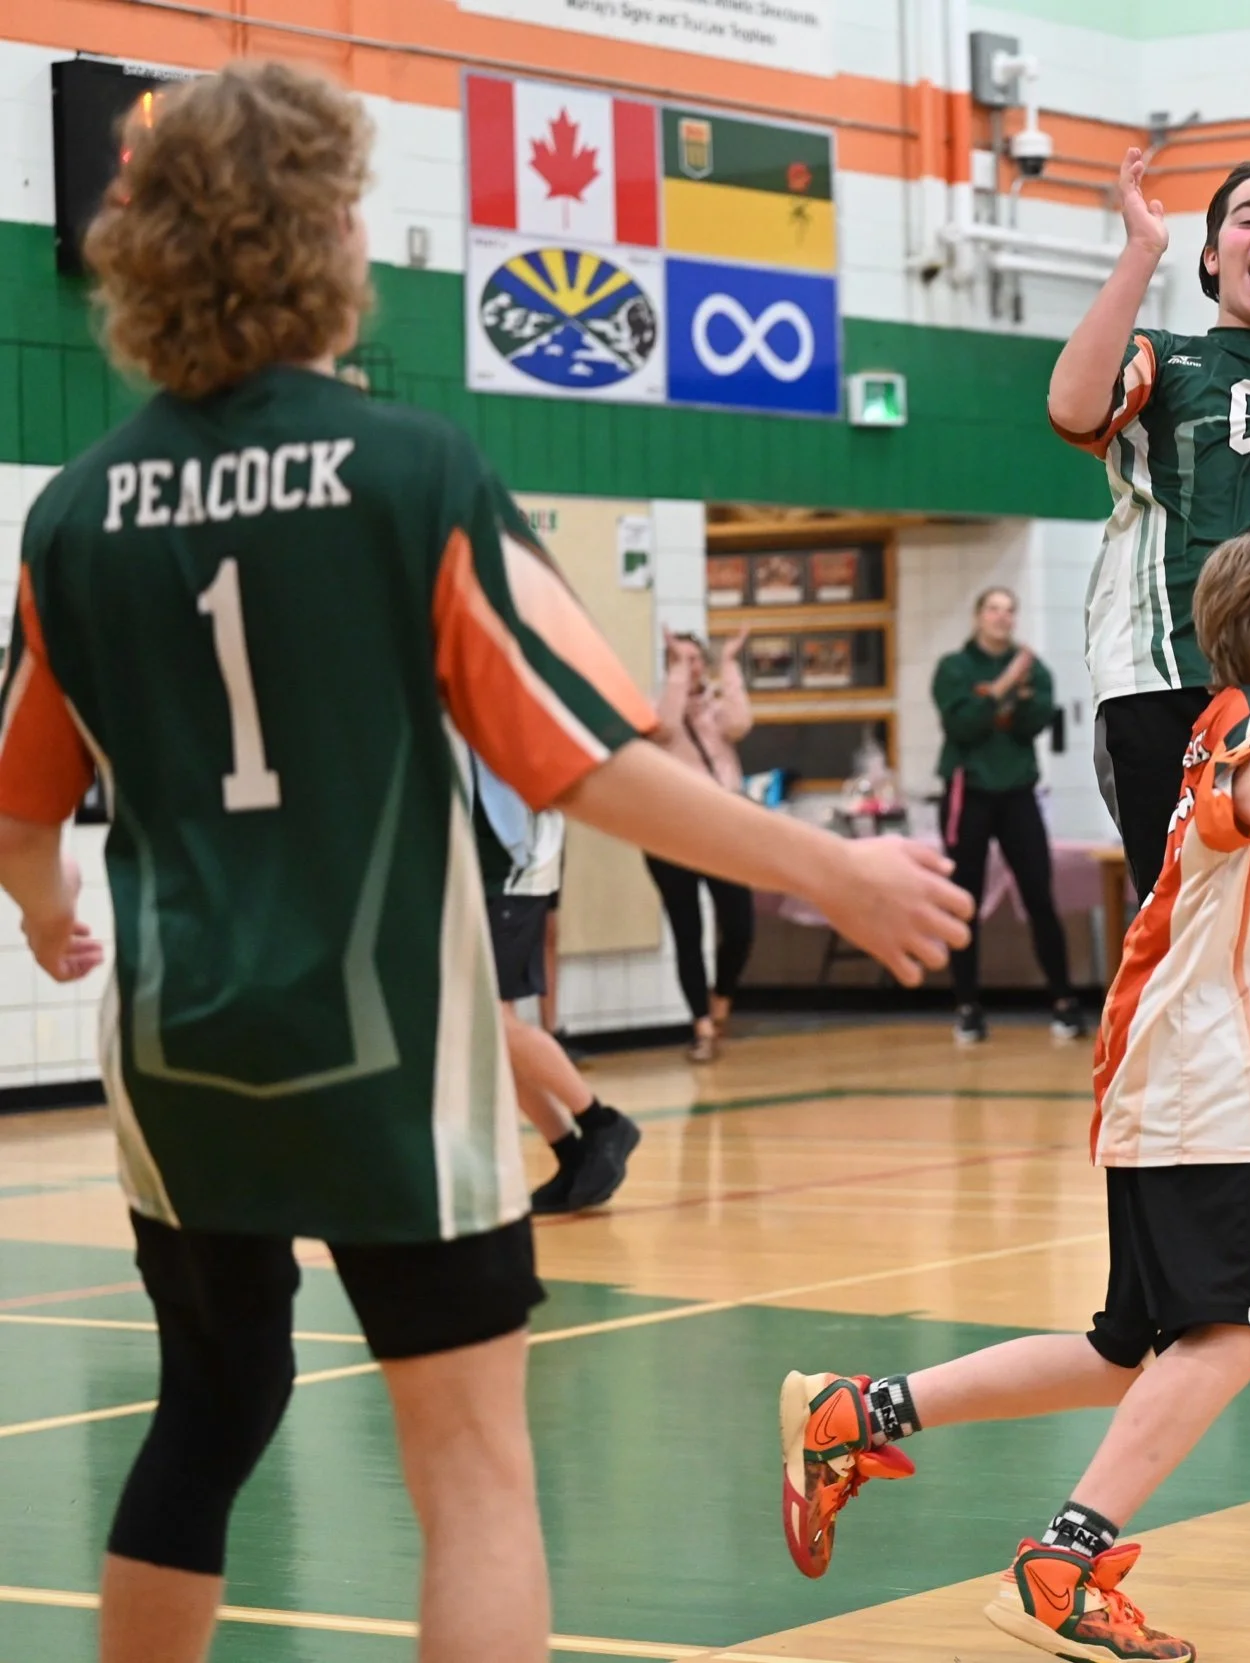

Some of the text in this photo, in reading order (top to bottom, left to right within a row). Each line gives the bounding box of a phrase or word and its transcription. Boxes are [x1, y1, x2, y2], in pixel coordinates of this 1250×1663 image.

[656, 13, 679, 27] and
[103, 437, 354, 533] PEACOCK
[197, 556, 282, 813] 1
